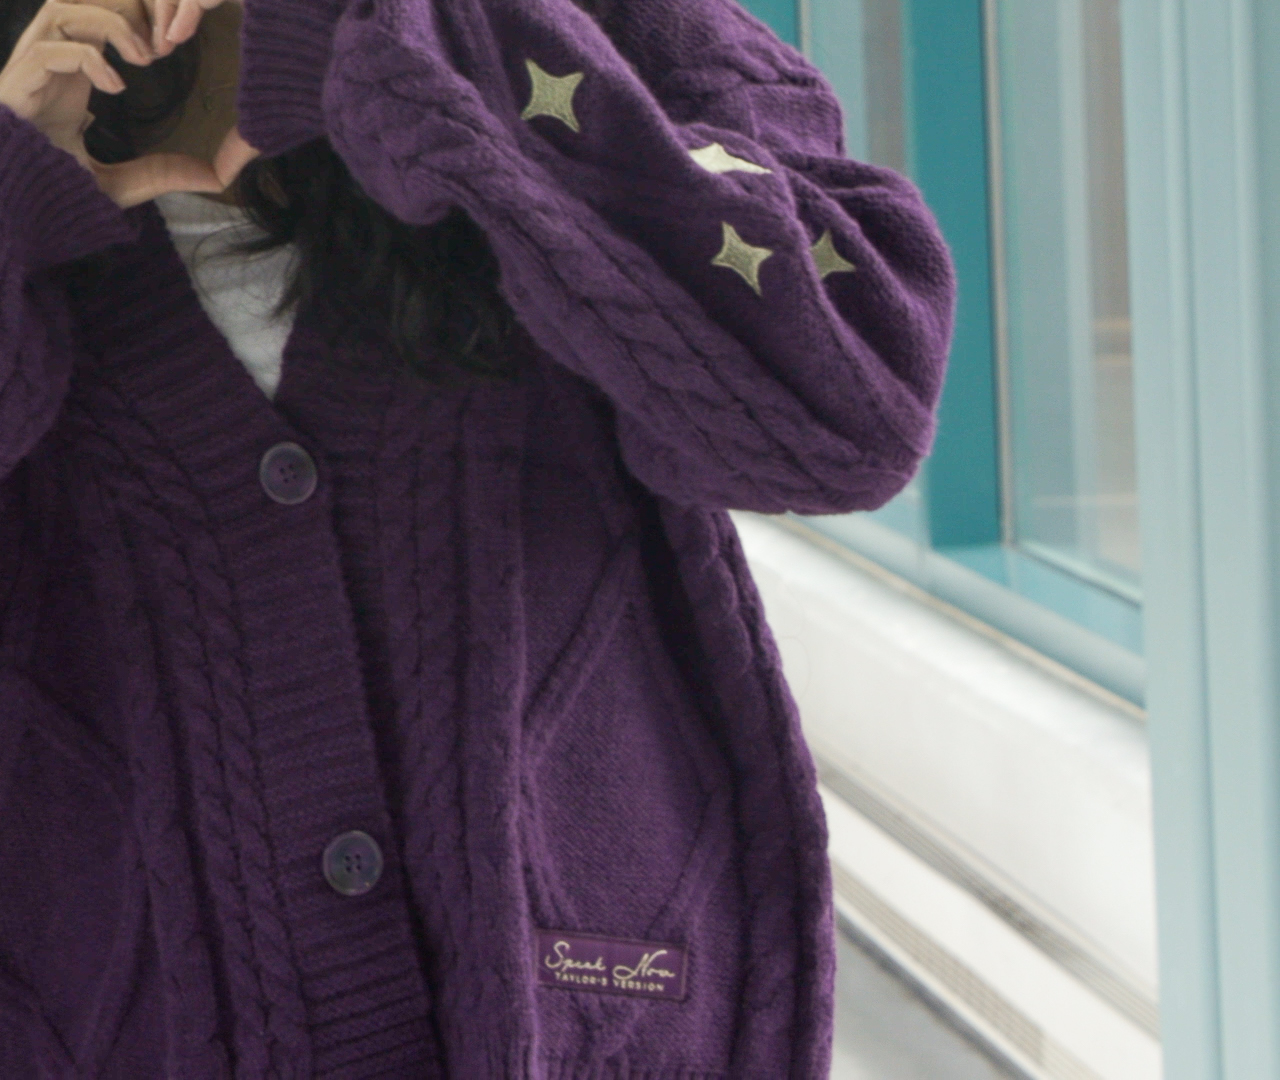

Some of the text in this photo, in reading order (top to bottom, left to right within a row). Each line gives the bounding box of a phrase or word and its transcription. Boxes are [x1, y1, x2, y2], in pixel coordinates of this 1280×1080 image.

[544, 940, 676, 981] Speak Now
[612, 978, 666, 993] VERSION
